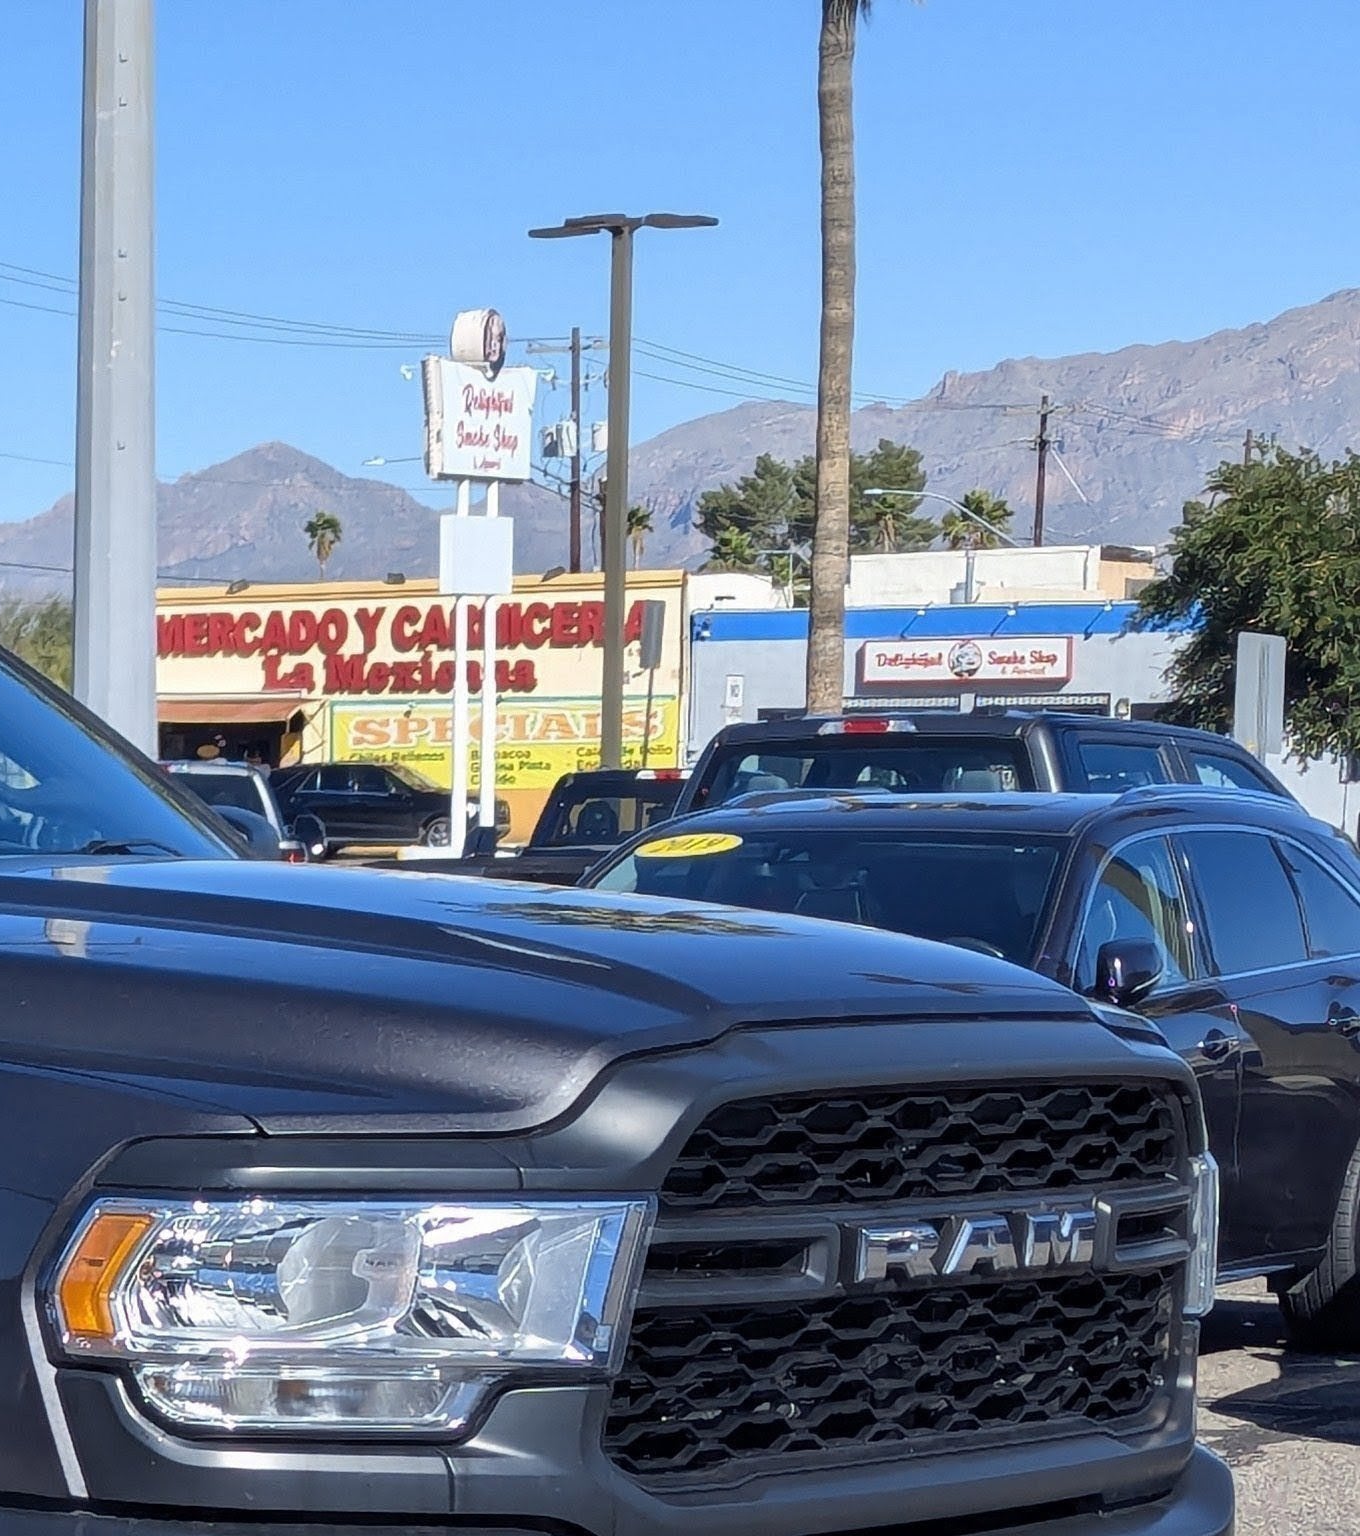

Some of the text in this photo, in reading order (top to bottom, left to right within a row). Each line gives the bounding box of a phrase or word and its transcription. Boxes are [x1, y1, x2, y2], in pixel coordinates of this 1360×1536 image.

[156, 600, 645, 659] MERCADO Y CARNICERA
[262, 652, 315, 692] La
[351, 709, 660, 747] SPECIALS
[470, 750, 532, 761] Bacoa
[470, 762, 514, 773] Gina
[854, 1210, 1097, 1283] RAM
